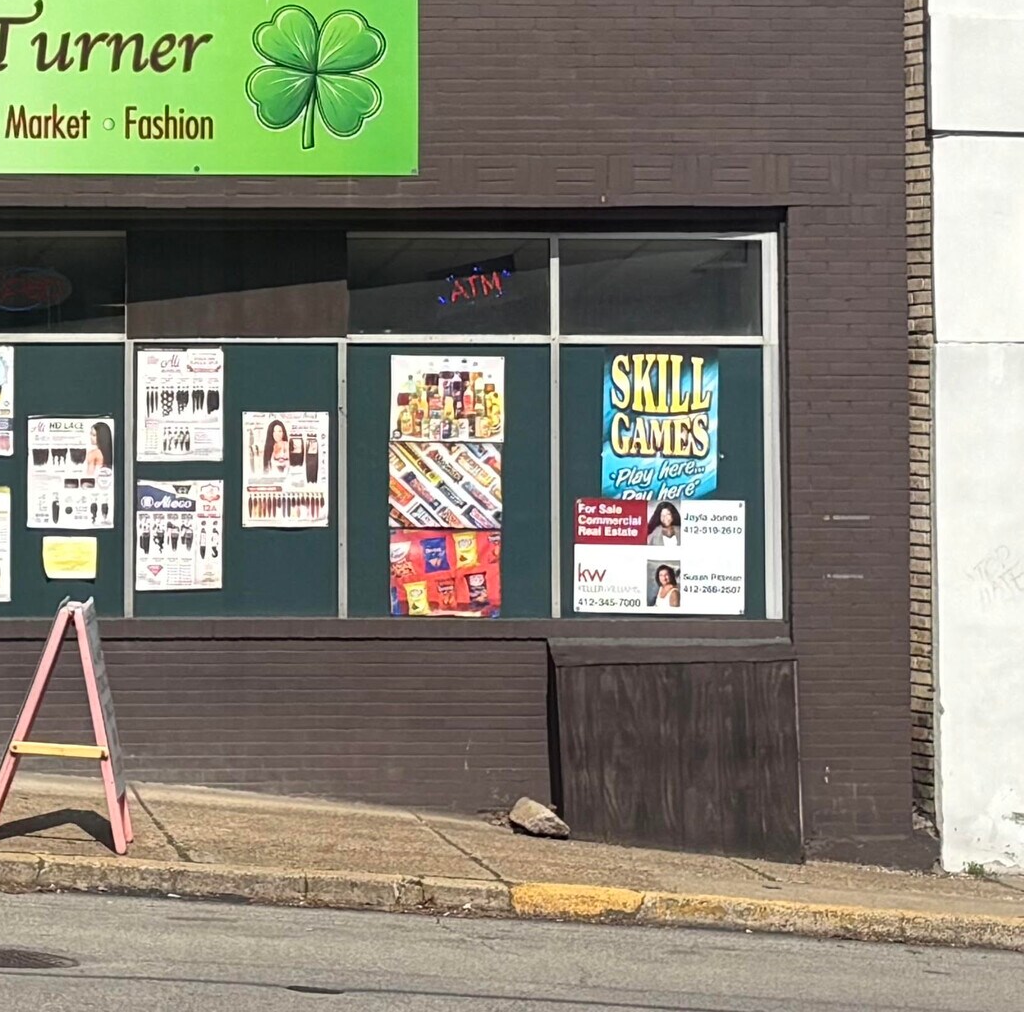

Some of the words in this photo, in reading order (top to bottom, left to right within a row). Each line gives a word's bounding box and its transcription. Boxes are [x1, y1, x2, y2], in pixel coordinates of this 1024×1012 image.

[5, 104, 91, 139] Market
[125, 104, 214, 140] Fashion
[451, 272, 502, 302] ATM
[611, 353, 712, 413] SKILL
[611, 412, 710, 456] GAMES
[578, 503, 595, 514] For
[599, 503, 622, 514] Sale
[577, 515, 642, 526] Commercial
[578, 526, 601, 536] Real
[604, 526, 639, 537] Estate
[578, 598, 641, 607] 412-345-7000
